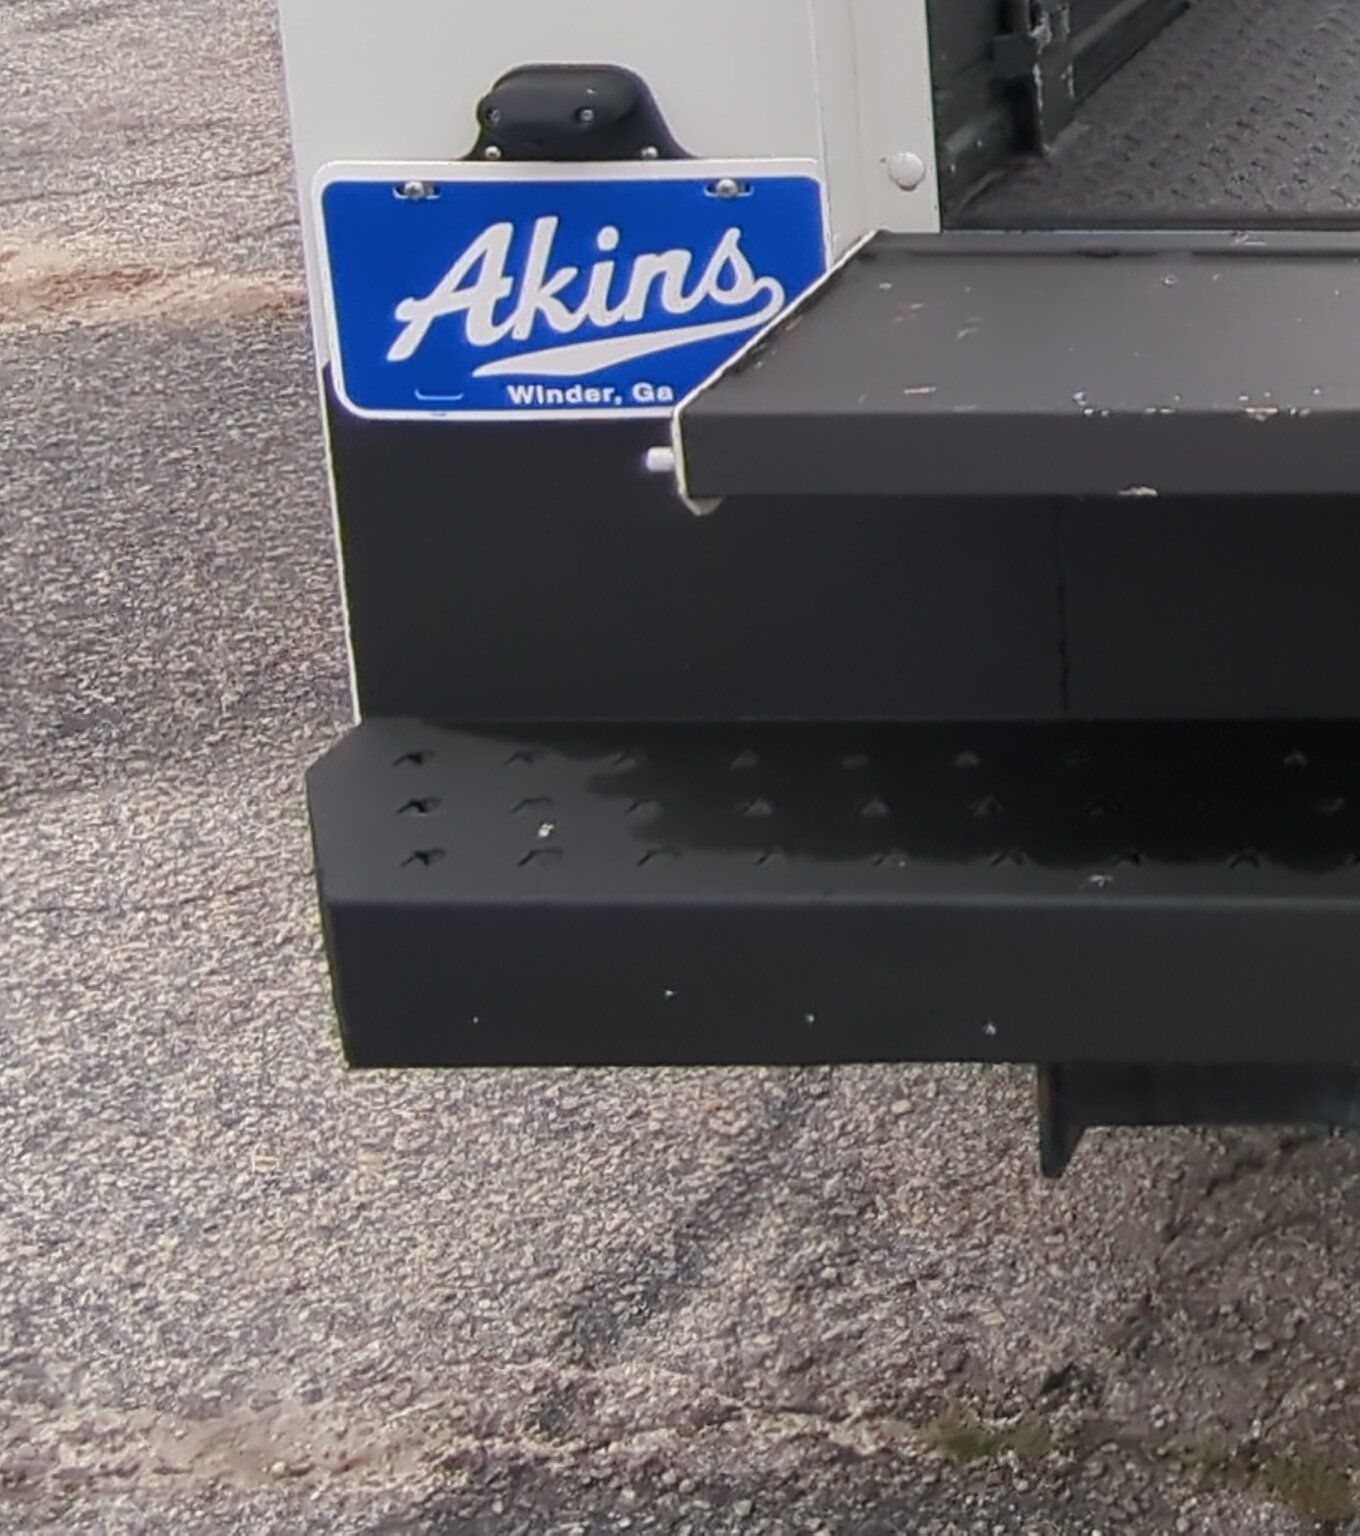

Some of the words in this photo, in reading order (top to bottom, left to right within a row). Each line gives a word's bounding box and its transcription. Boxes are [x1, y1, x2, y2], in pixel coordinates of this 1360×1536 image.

[386, 216, 784, 368] Akins
[506, 384, 623, 406] Winder,
[632, 381, 674, 402] Ga
